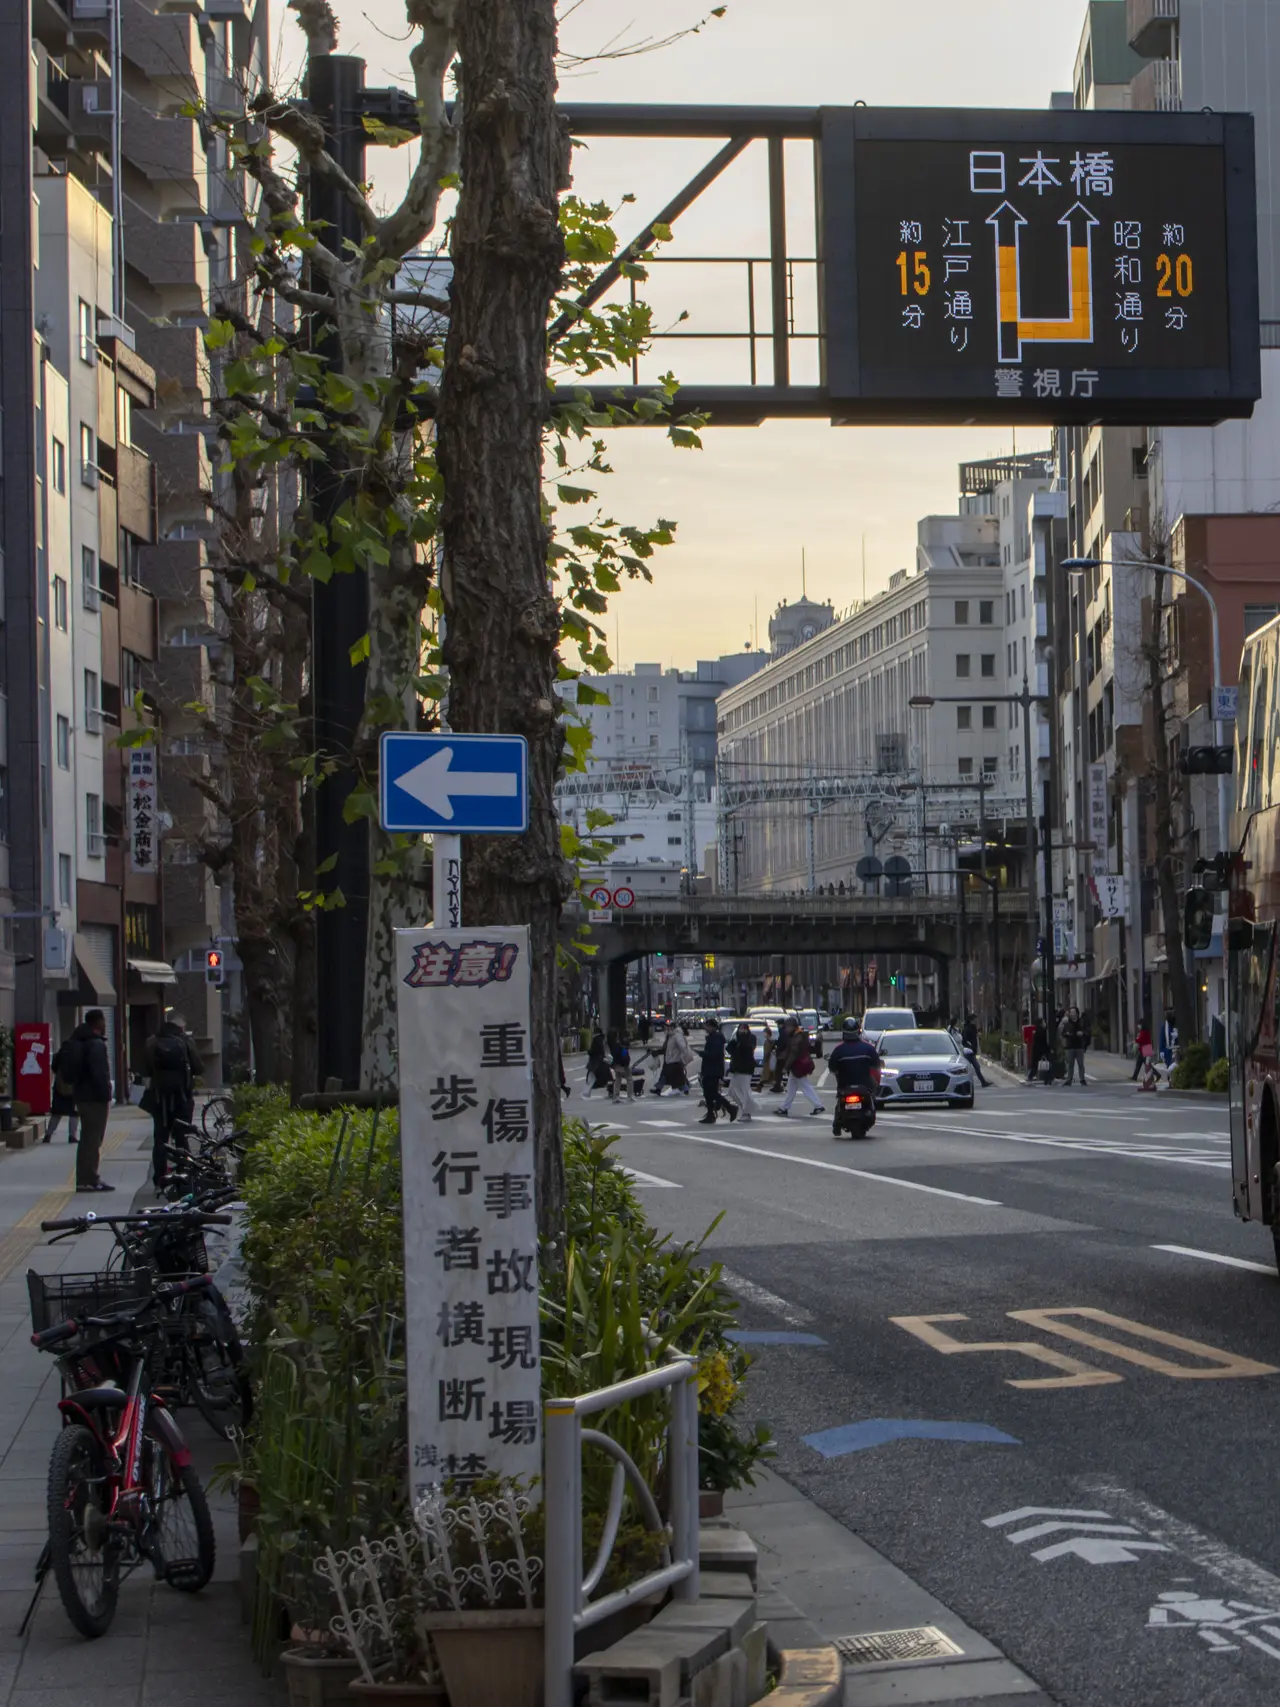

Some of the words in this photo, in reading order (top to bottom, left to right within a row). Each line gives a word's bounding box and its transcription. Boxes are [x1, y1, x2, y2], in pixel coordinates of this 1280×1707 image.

[969, 150, 1114, 197] 日本橋
[941, 217, 974, 353] 江戸通り
[1112, 220, 1144, 353] 昭和通り
[993, 367, 1100, 399] 警視庁
[479, 1022, 538, 1445] 重傷事故現場
